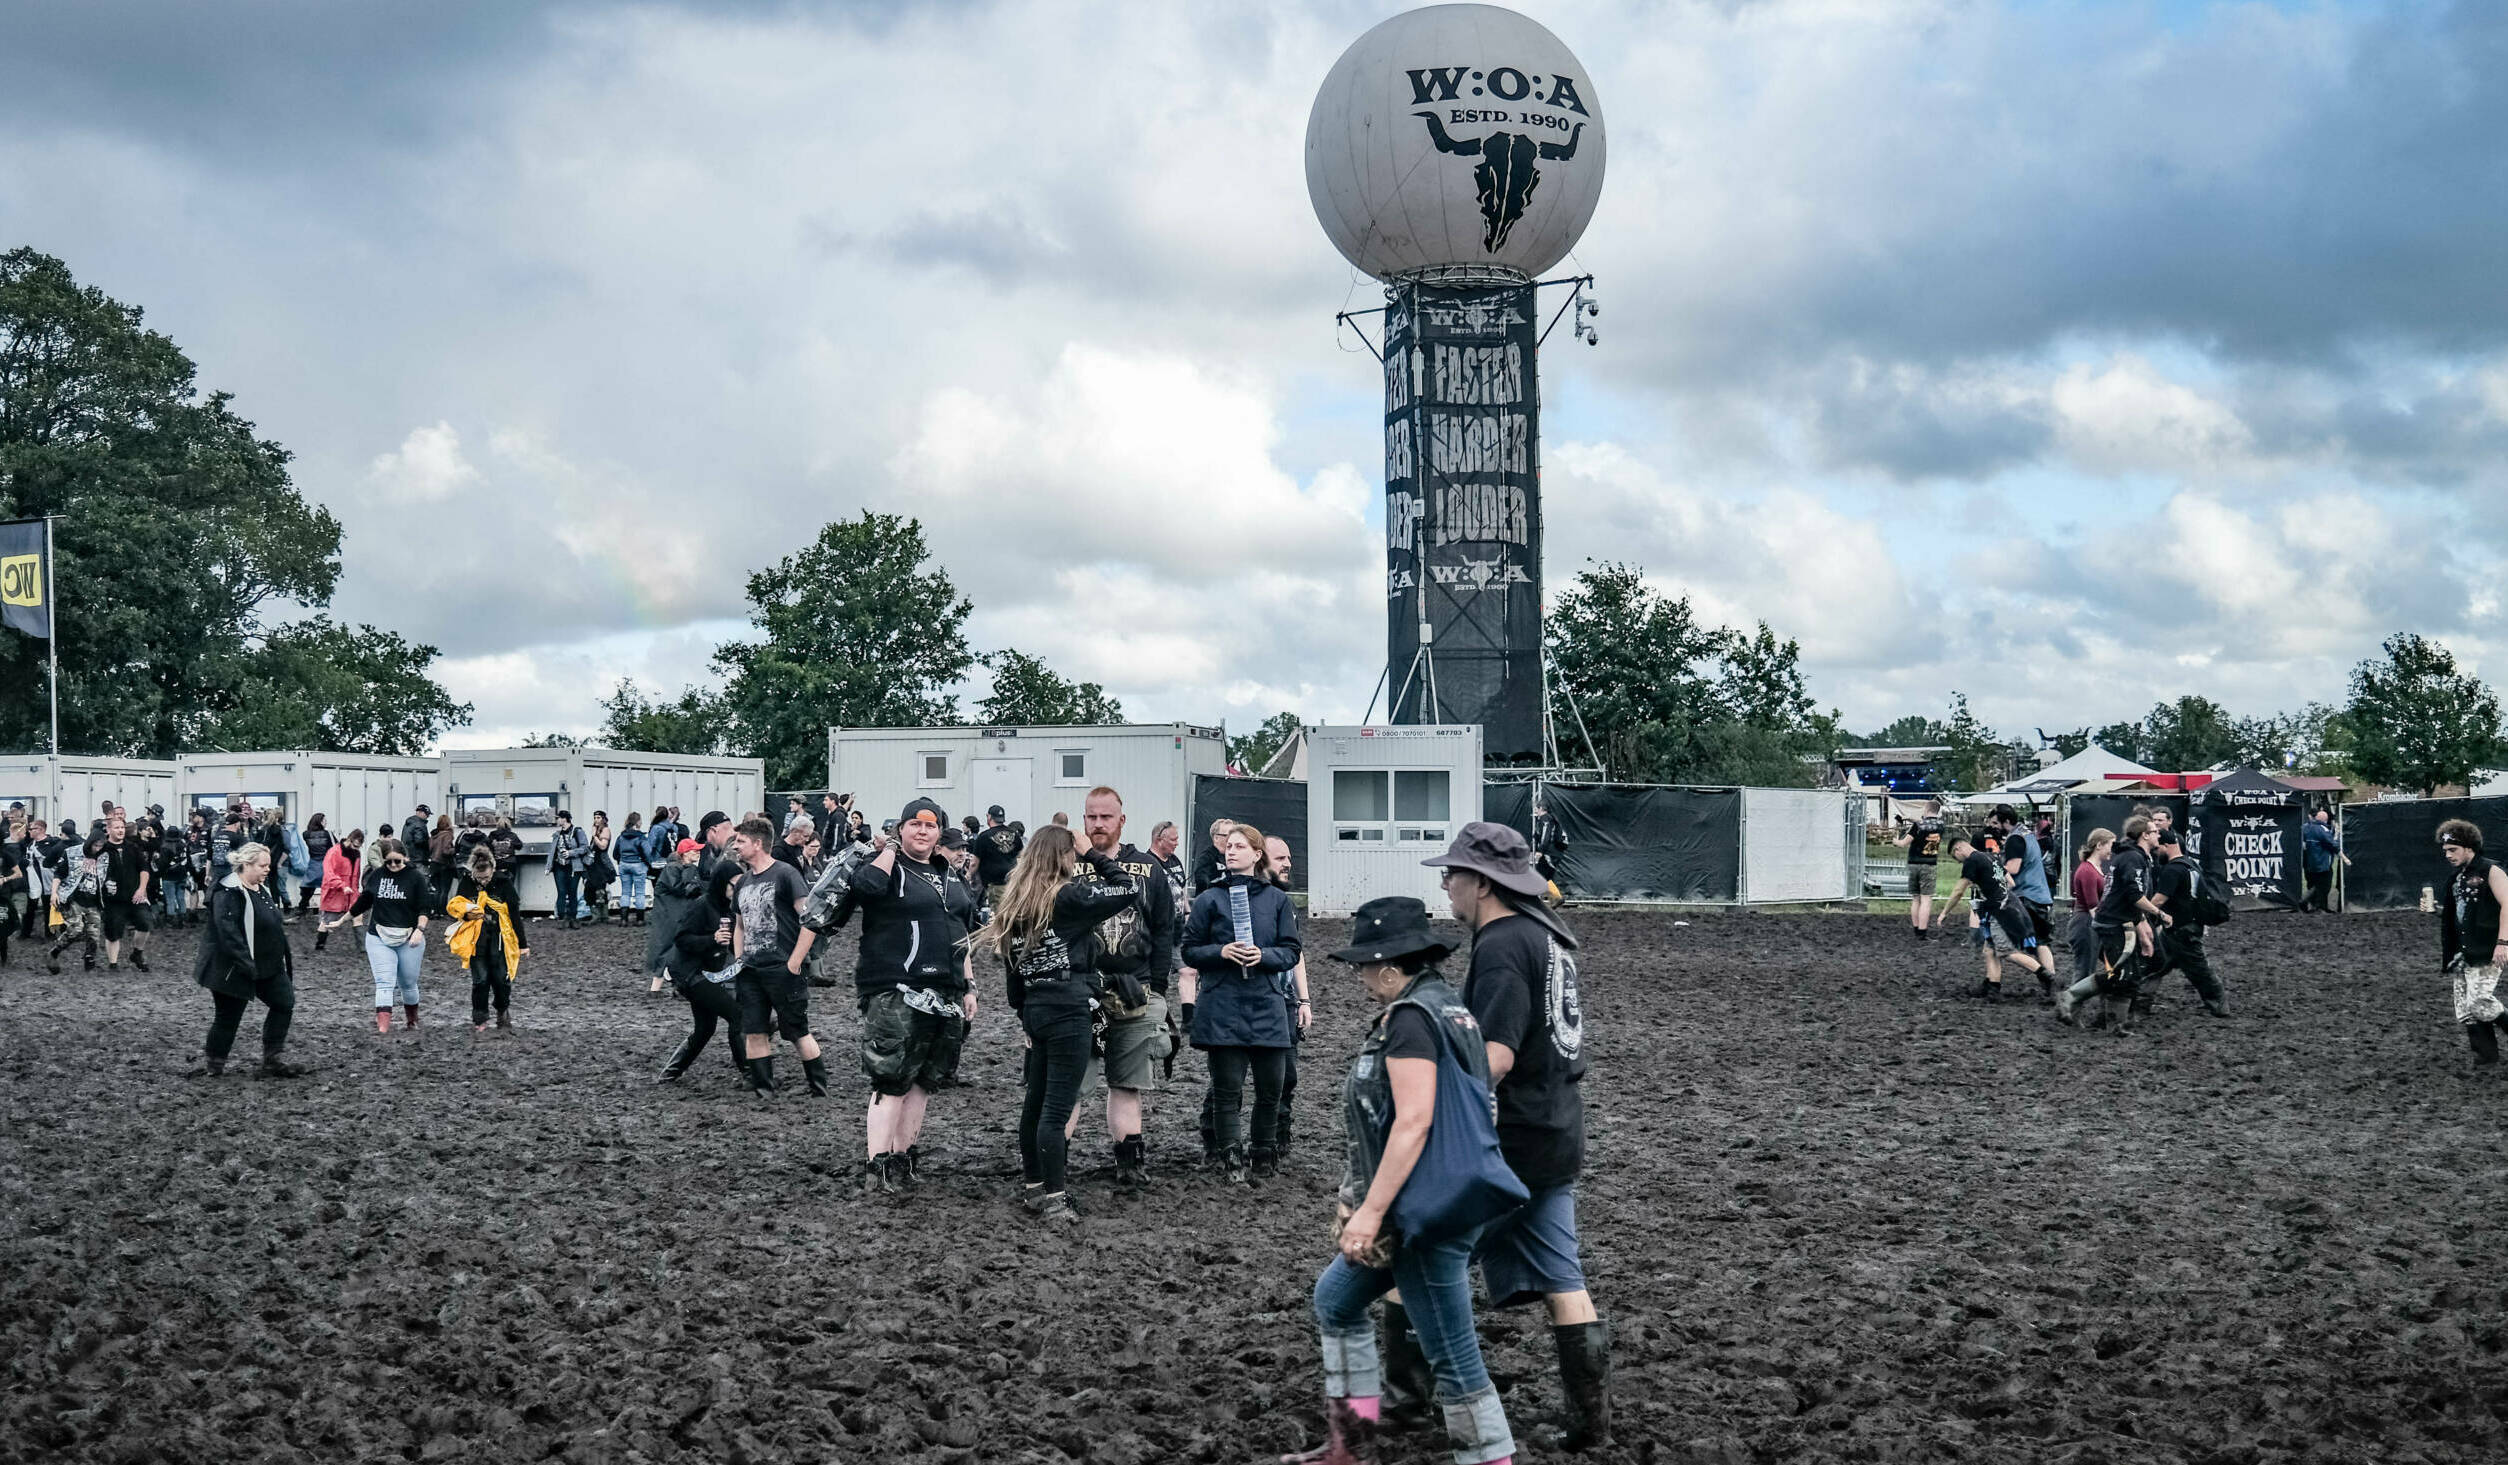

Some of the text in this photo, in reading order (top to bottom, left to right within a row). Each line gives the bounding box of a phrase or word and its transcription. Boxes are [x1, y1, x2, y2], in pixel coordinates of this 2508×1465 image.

[1406, 67, 1590, 118] W:O:A
[1450, 109, 1570, 131] ESTD. 1990
[1434, 342, 1522, 405] FASTER
[1431, 413, 1528, 477] HARDER
[1435, 484, 1528, 549] LOUDER
[2234, 796, 2278, 806] CHECK POINT
[2224, 830, 2284, 857] CHECK
[1072, 861, 1153, 878] WAKEN
[2224, 857, 2284, 882] POINT
